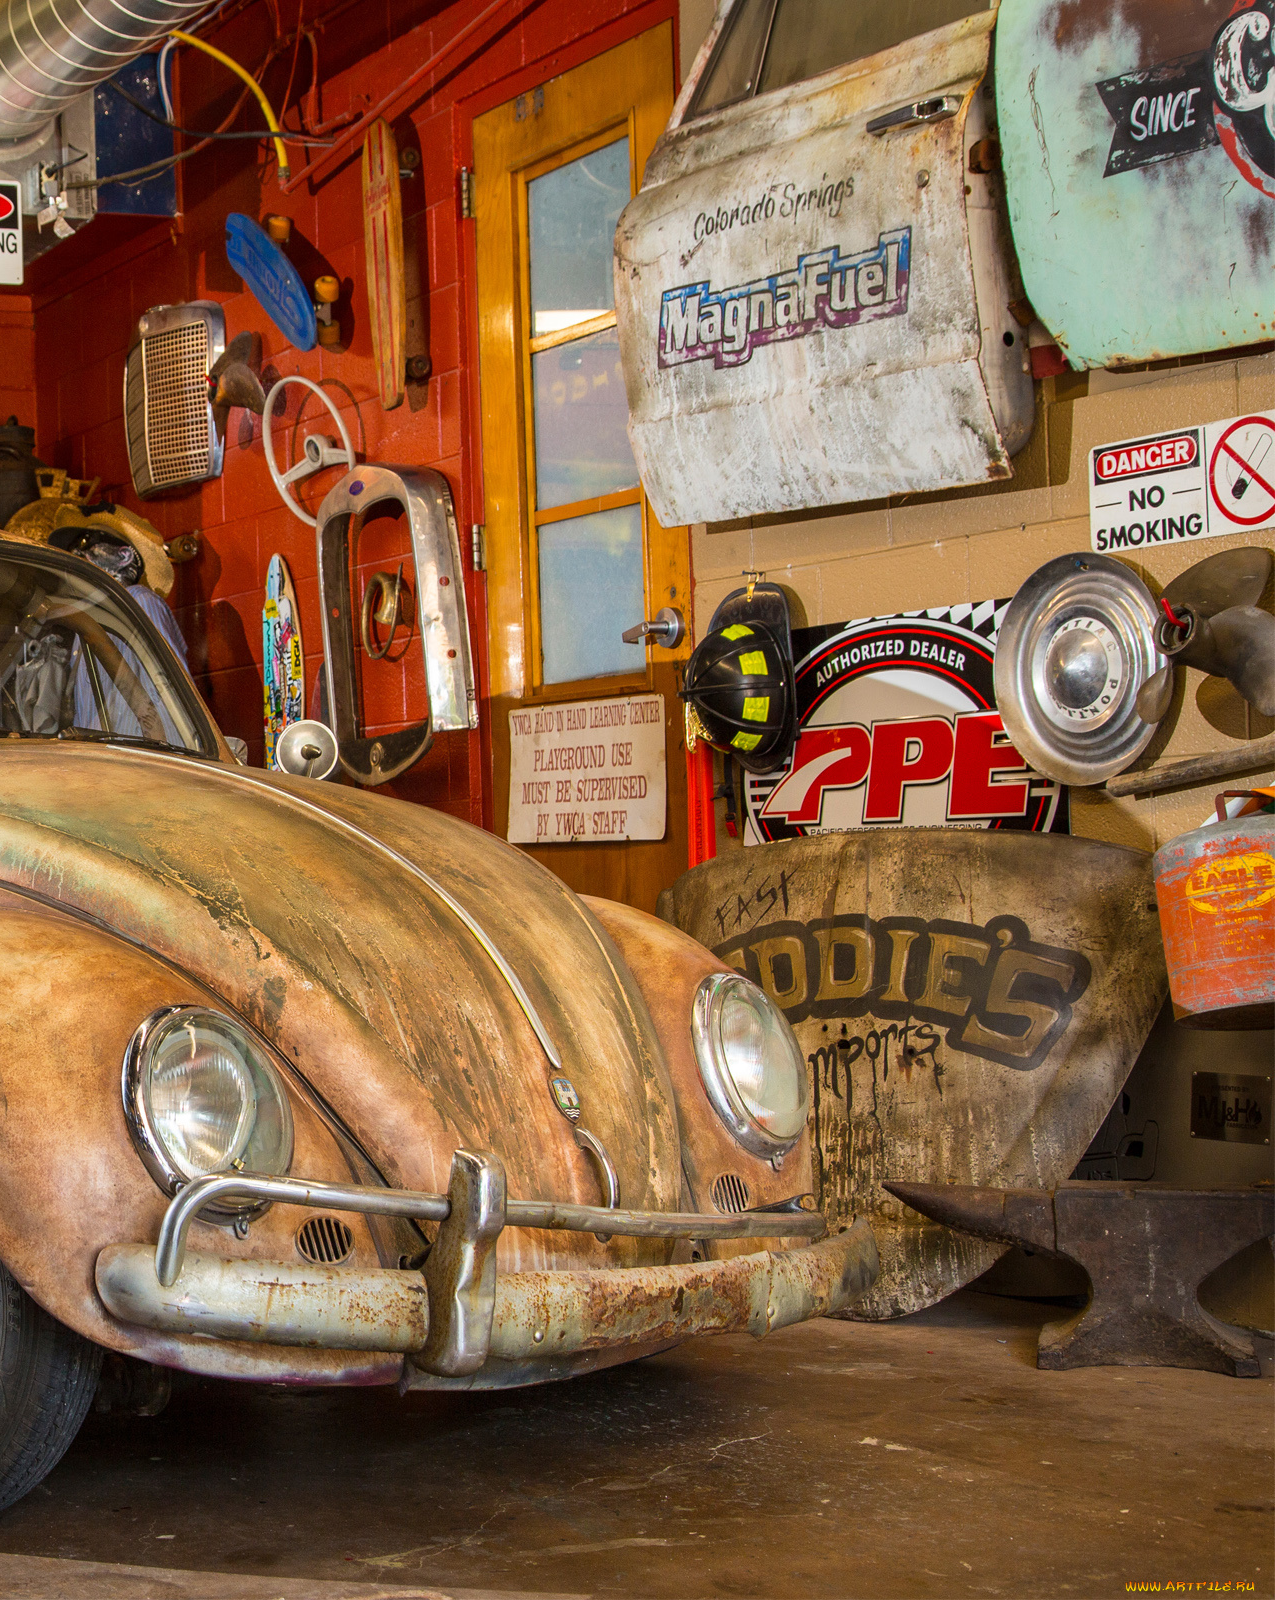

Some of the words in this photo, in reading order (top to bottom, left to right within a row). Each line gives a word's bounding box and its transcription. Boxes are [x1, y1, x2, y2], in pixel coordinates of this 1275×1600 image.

[1130, 87, 1201, 141] SINCE
[693, 193, 775, 241] Colorado
[779, 176, 855, 225] Springs
[660, 233, 907, 361] MagnaFuel
[1102, 440, 1190, 477] DANGER
[1128, 485, 1165, 512] NO
[1096, 513, 1203, 551] SMOKING
[293, 639, 301, 668] DGK
[816, 639, 905, 688] AUTHORIZED
[909, 639, 966, 671] DEALER
[512, 715, 532, 736] YWCA
[534, 711, 555, 734] HAND
[556, 709, 565, 732] IN
[566, 707, 587, 731] HAND
[589, 703, 627, 729] LEARNING
[629, 700, 661, 725] CENTER
[533, 744, 606, 772] PLAYGROUND
[611, 742, 633, 767] USE
[759, 710, 1031, 826] PPE
[521, 781, 551, 805] MUST
[555, 779, 572, 803] BE
[576, 774, 648, 802] SUPERVISED
[536, 813, 550, 837] BY
[555, 811, 586, 836] YWCA
[592, 810, 628, 835] STAFF
[713, 869, 797, 938] FAST
[808, 1017, 942, 1100] mports
